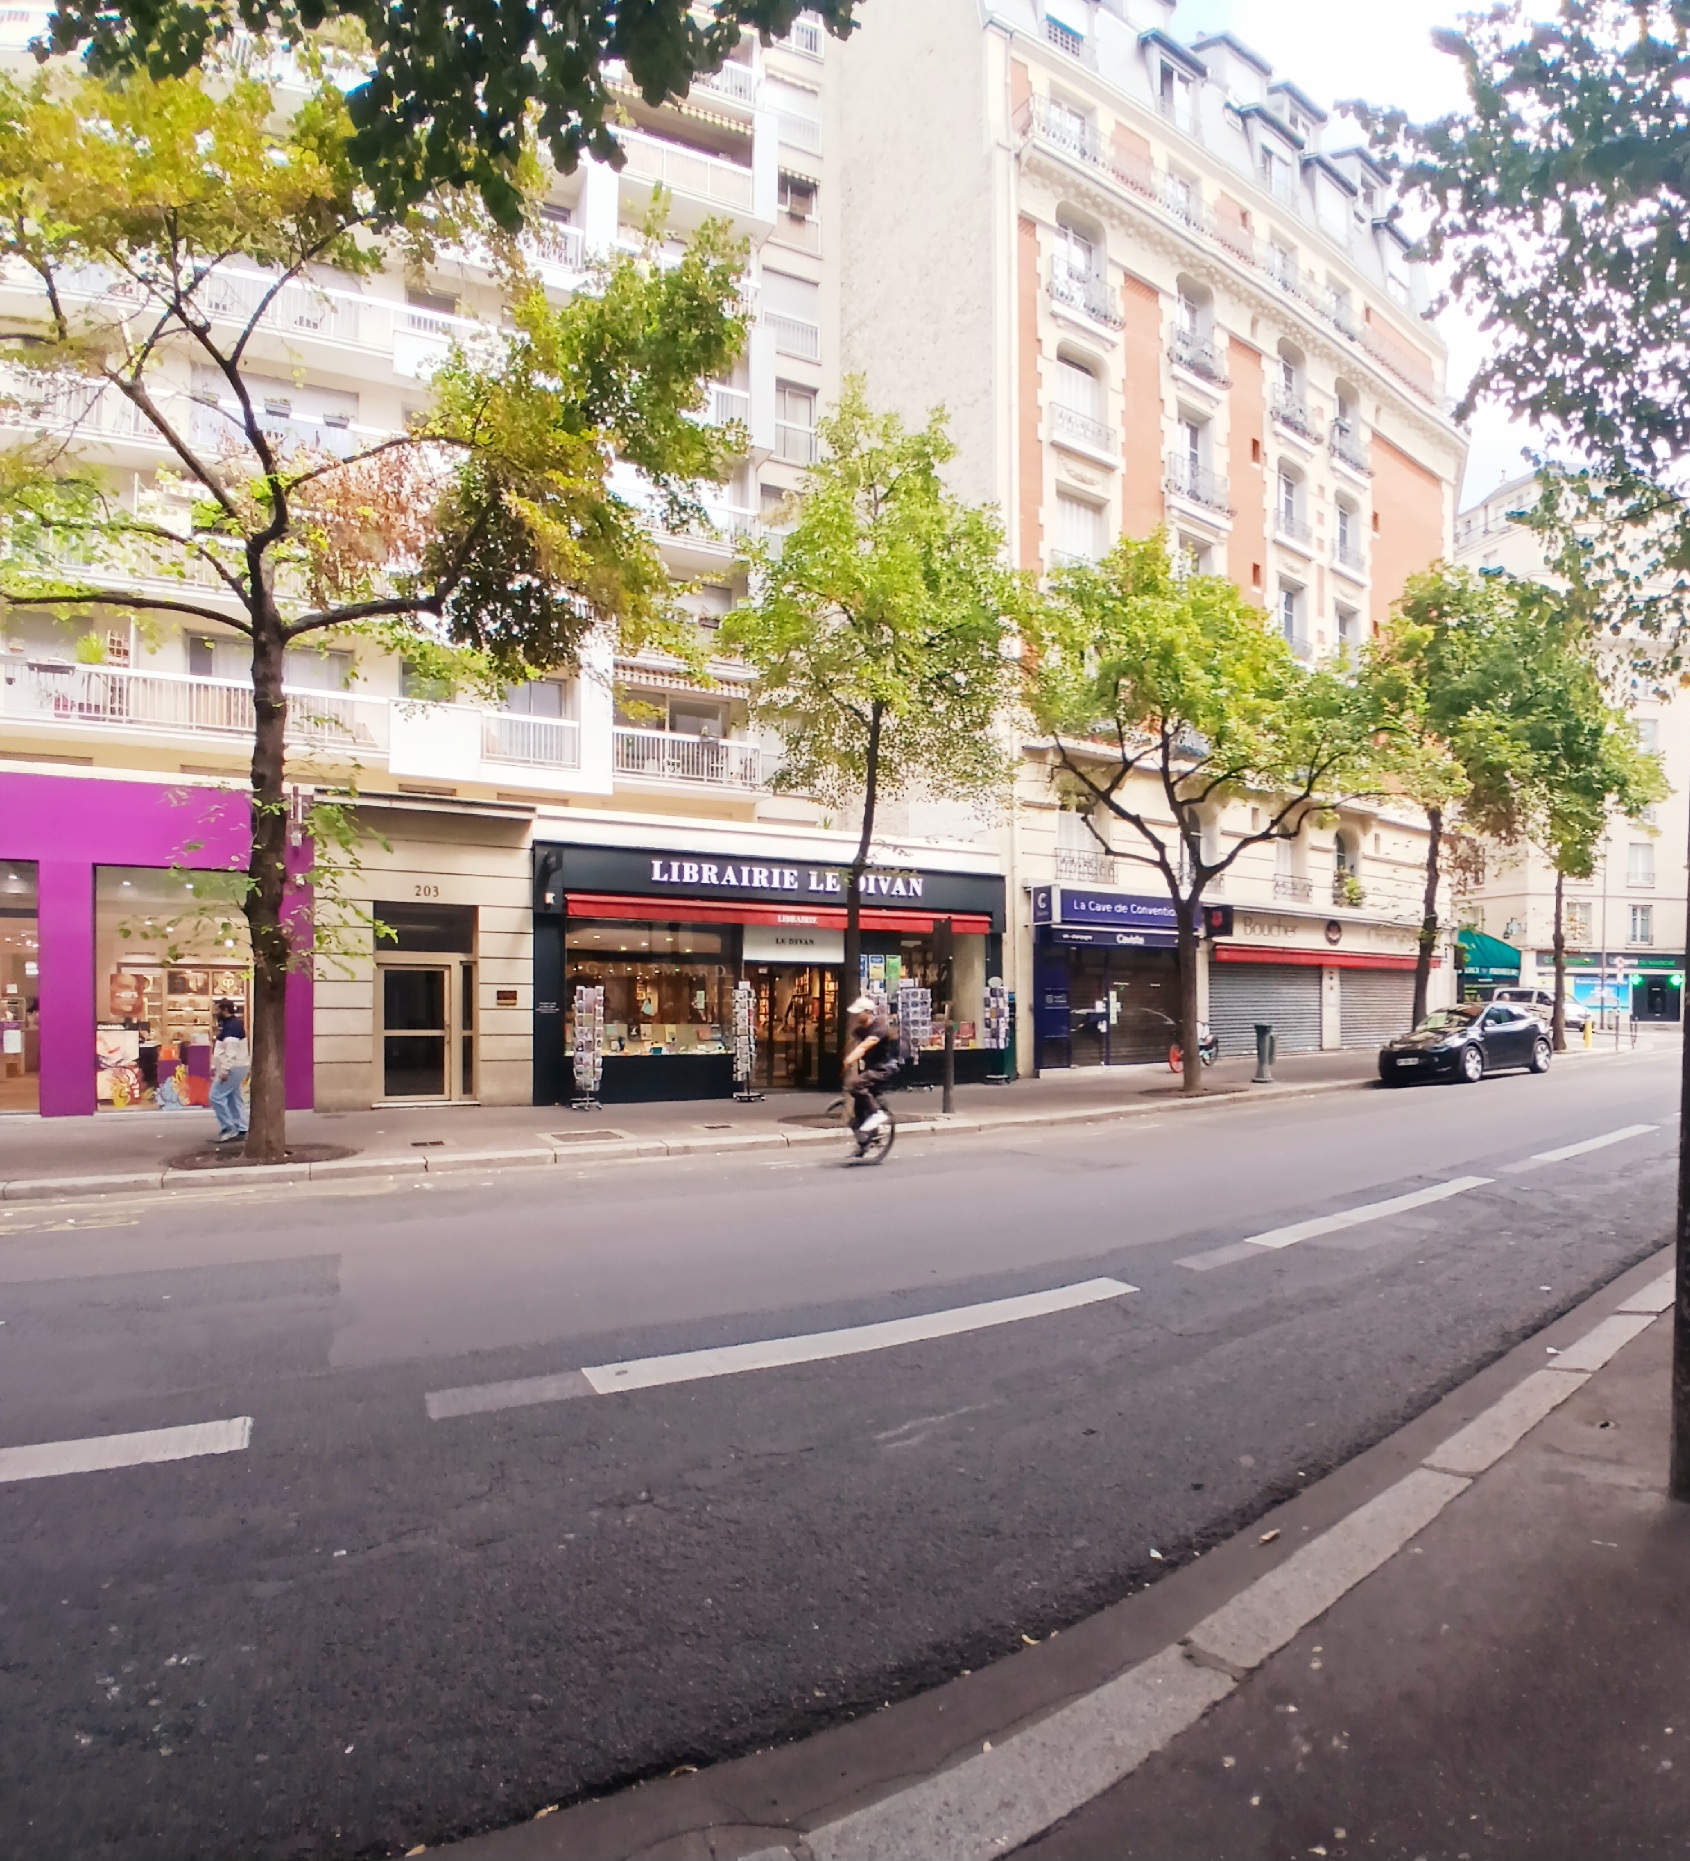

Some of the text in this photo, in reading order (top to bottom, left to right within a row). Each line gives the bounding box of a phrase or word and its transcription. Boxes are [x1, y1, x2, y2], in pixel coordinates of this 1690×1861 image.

[650, 860, 799, 891] LIBRAIRIE
[808, 869, 841, 894] LE
[414, 885, 440, 898] 203
[1073, 899, 1179, 917] La Cave de Conventio
[777, 914, 818, 925] LIBRAIRIE
[1243, 916, 1299, 939] Boucher
[776, 937, 815, 945] LE DIVAN
